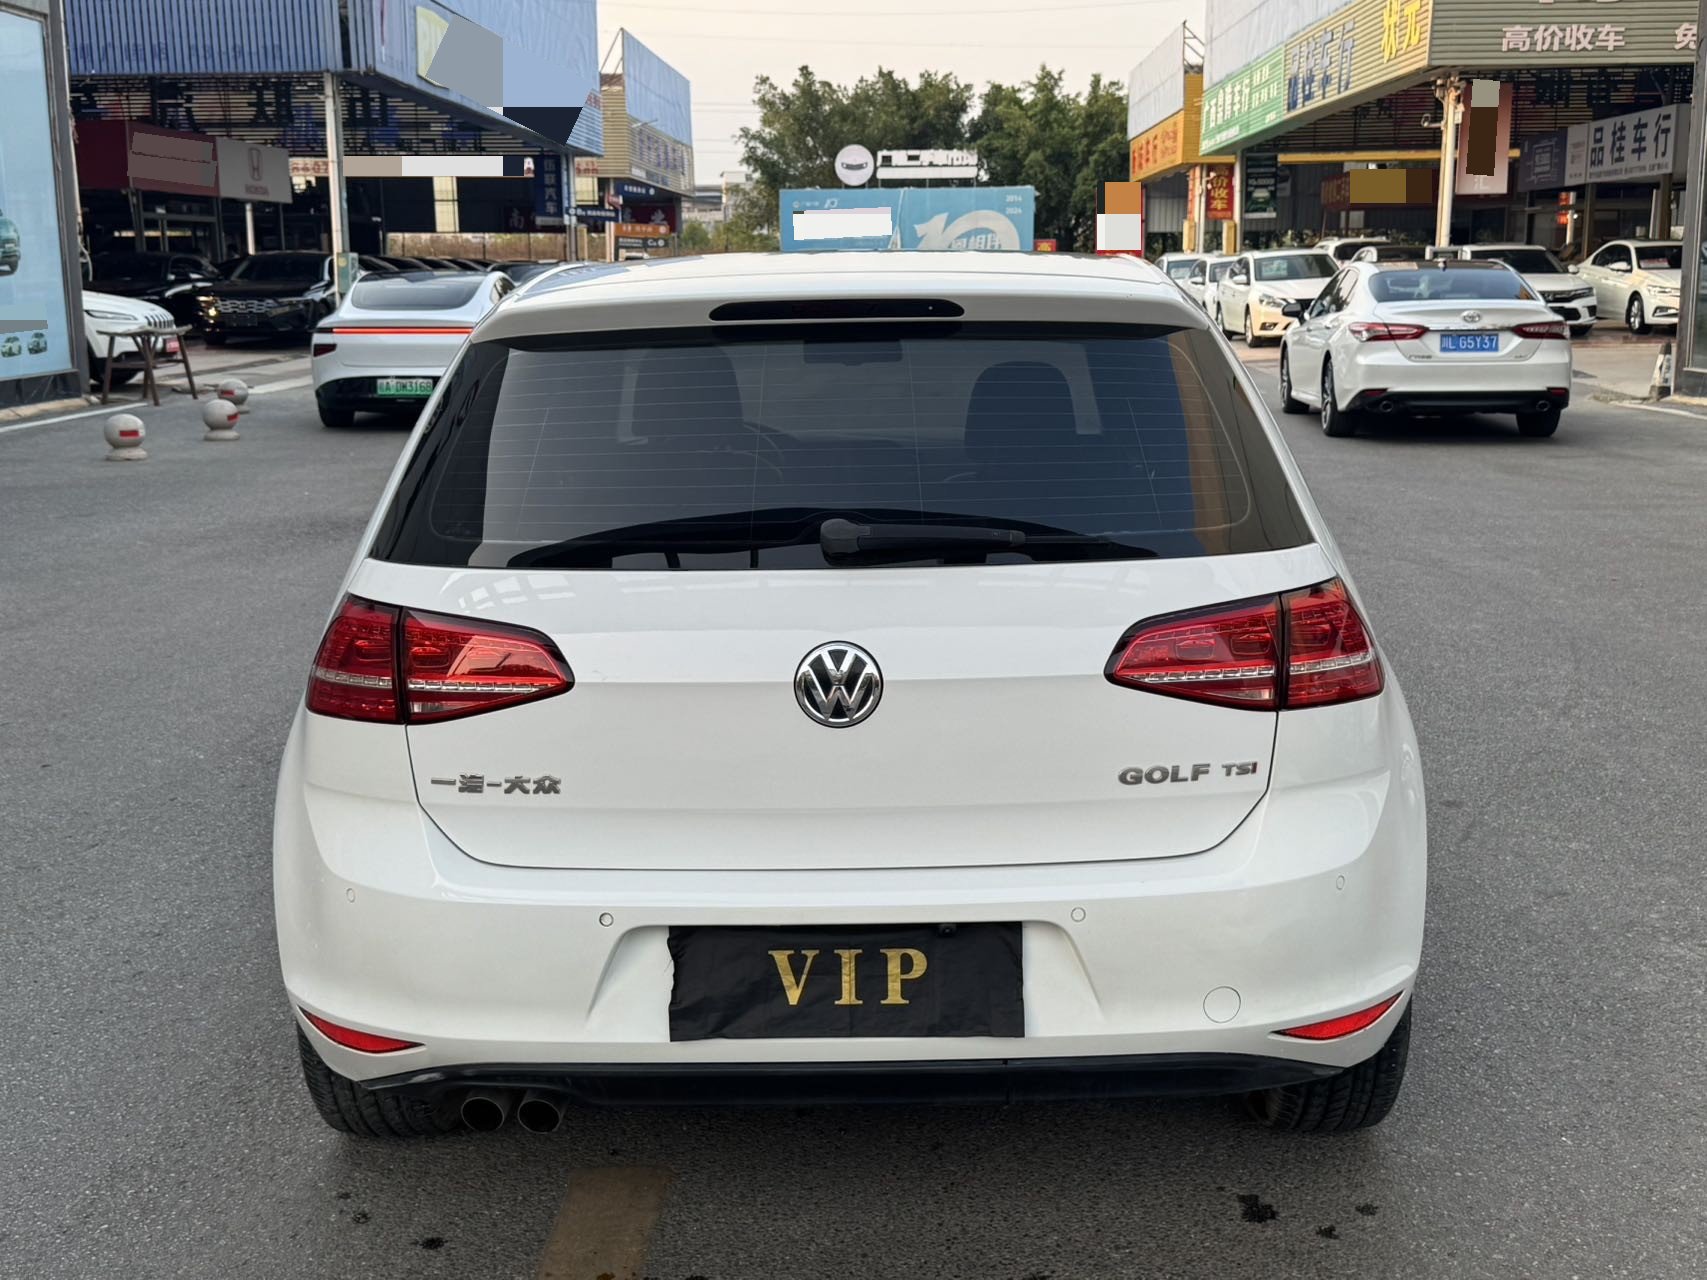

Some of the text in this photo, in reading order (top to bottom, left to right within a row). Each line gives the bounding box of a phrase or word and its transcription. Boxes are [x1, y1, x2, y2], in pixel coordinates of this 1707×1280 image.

[1501, 24, 1626, 52] 高价收车
[1287, 19, 1355, 112] 品桂车行
[1590, 112, 1672, 168] 品桂车行
[1211, 165, 1230, 211] 高价收车
[1118, 762, 1258, 785] GOLF TSI
[767, 946, 929, 1006] VIP
